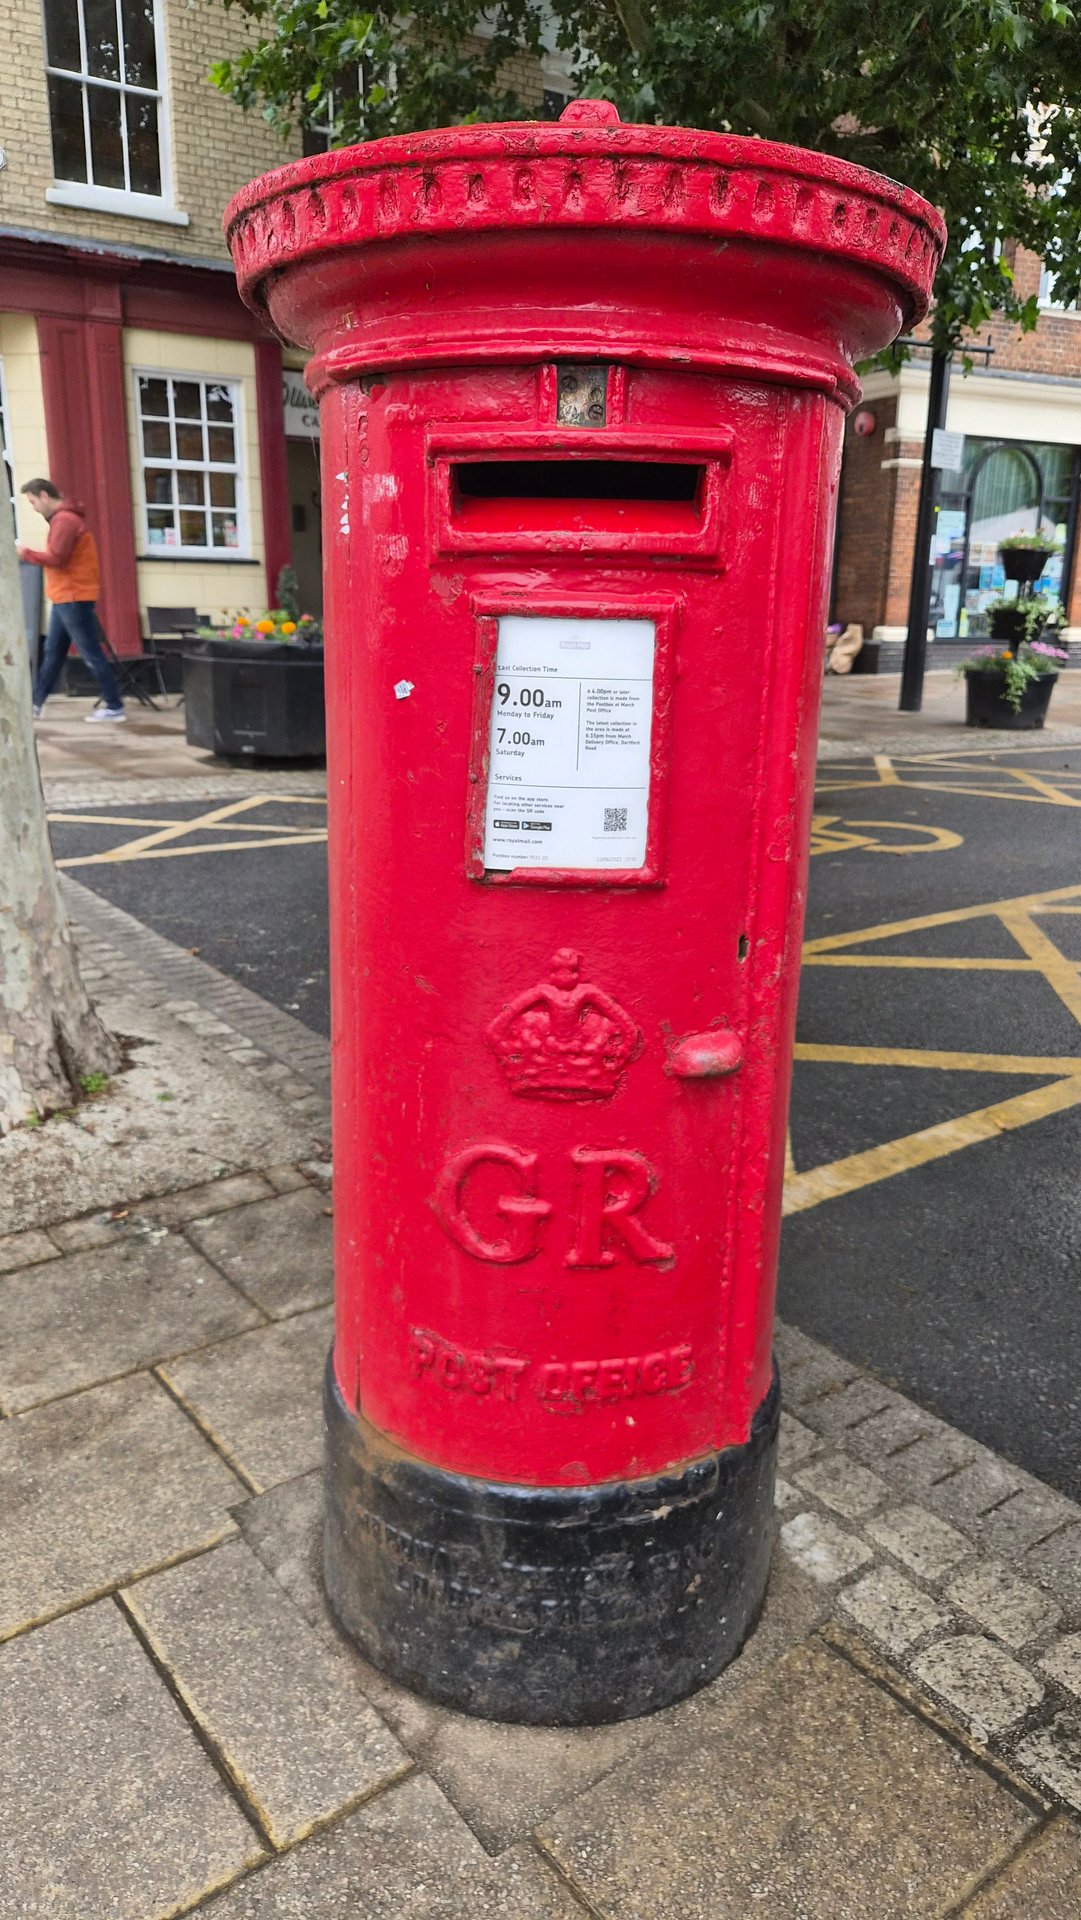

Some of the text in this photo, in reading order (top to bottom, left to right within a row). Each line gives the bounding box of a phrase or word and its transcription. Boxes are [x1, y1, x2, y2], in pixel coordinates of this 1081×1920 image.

[497, 683, 562, 708] 9.00am
[497, 710, 522, 718] Monday
[533, 712, 554, 720] Friday
[497, 728, 545, 746] 7.00am
[496, 748, 525, 757] Saturday
[494, 773, 522, 781] Services
[409, 1330, 530, 1400] POST
